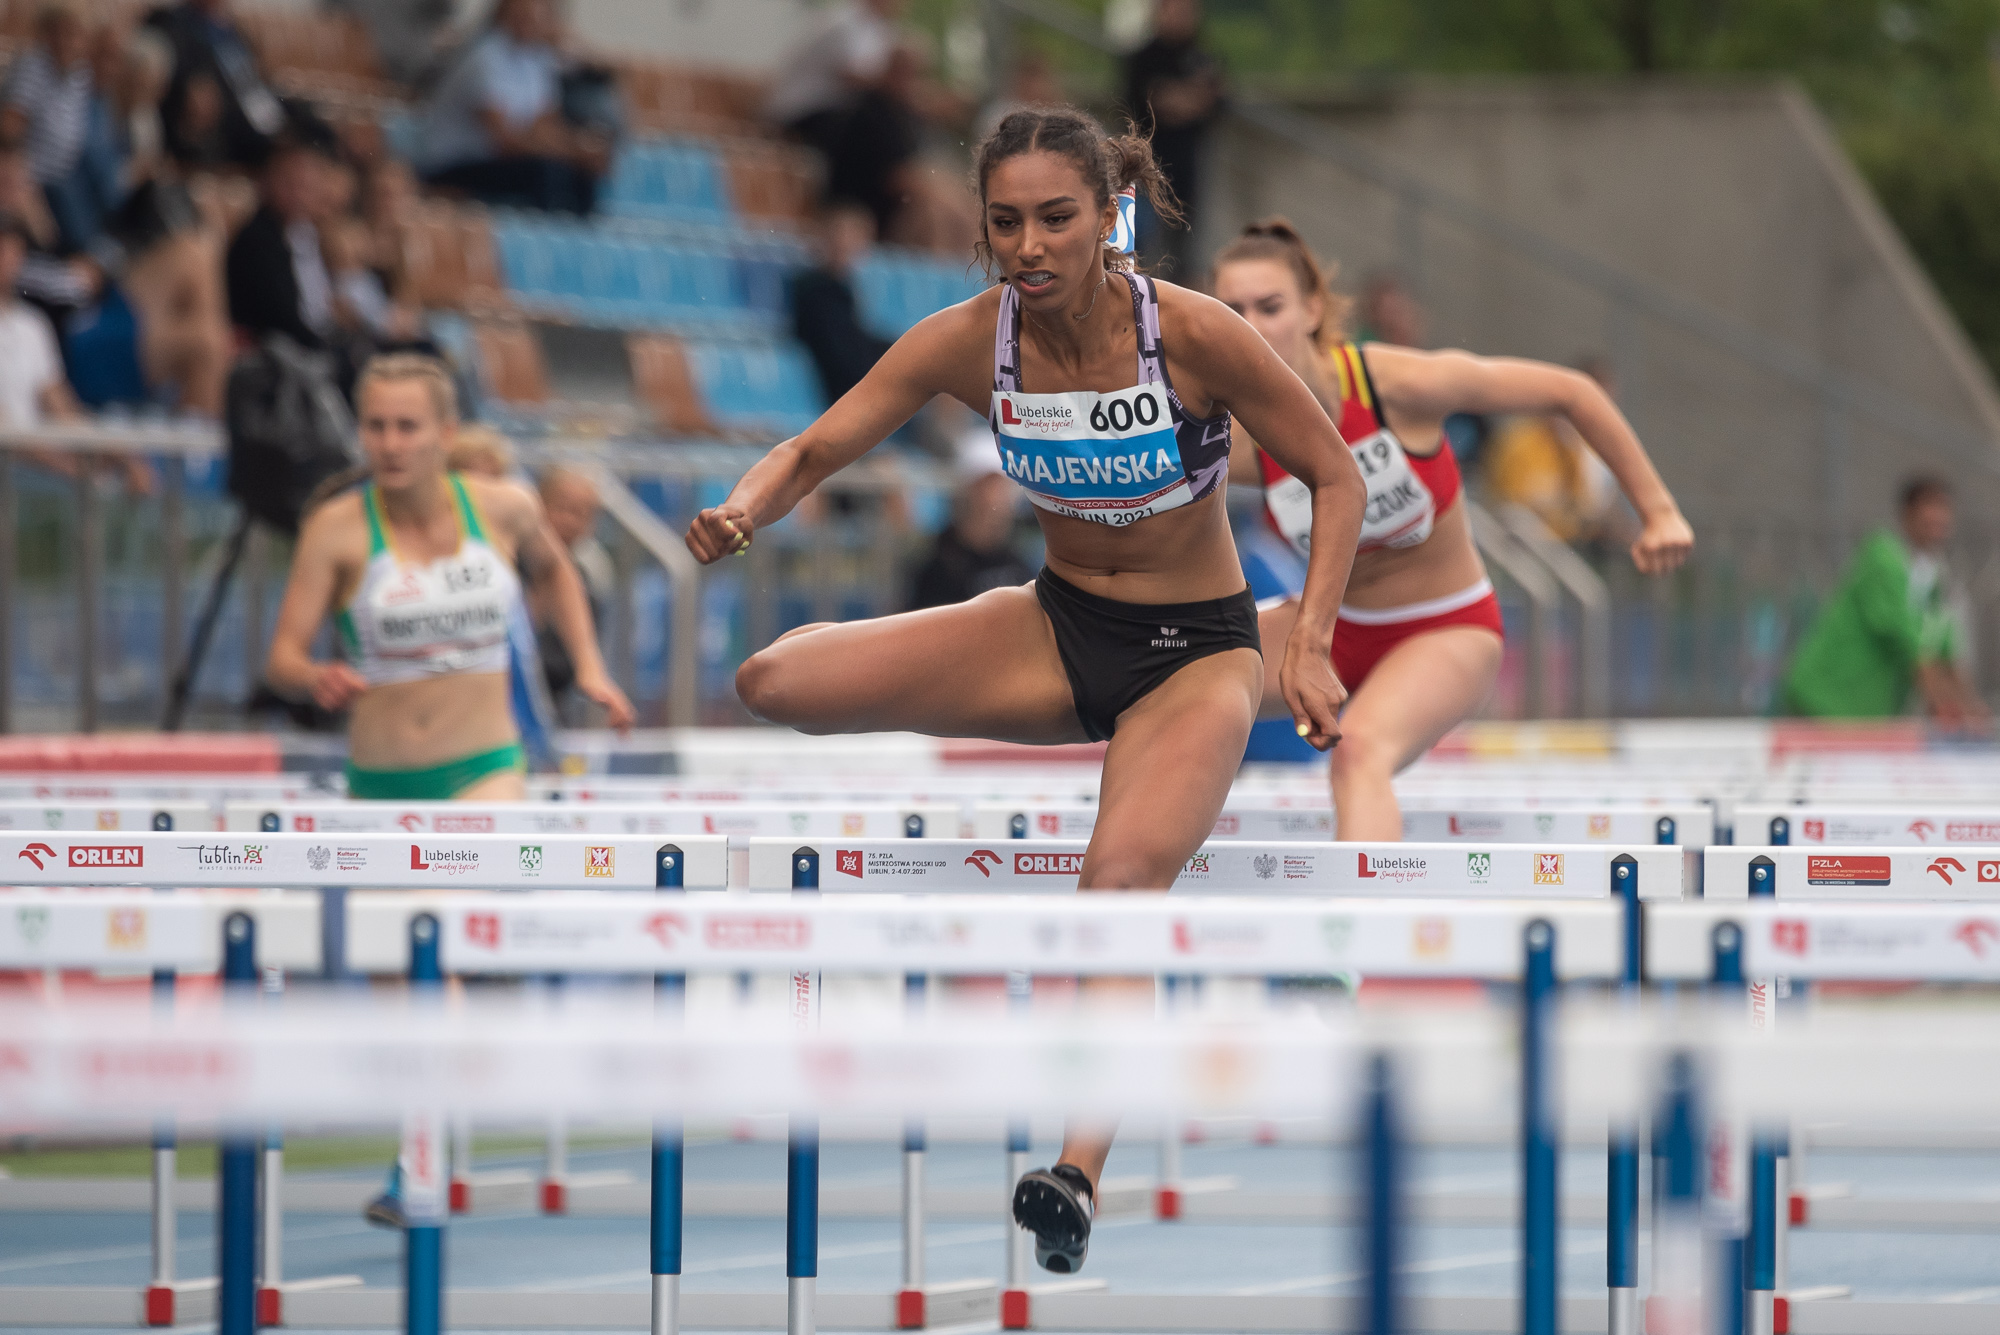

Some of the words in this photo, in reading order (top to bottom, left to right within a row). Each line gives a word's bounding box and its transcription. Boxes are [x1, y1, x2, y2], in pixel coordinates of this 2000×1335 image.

[1090, 392, 1160, 432] 600
[1358, 438, 1391, 475] 19
[1006, 448, 1178, 485] MAJEWSKA
[1112, 506, 1154, 525] 2021
[1151, 638, 1187, 647] erima
[72, 848, 139, 865] ORLEN
[1018, 856, 1085, 872] ORLEN
[586, 867, 613, 876] PZLA
[1535, 874, 1562, 883] PZLA
